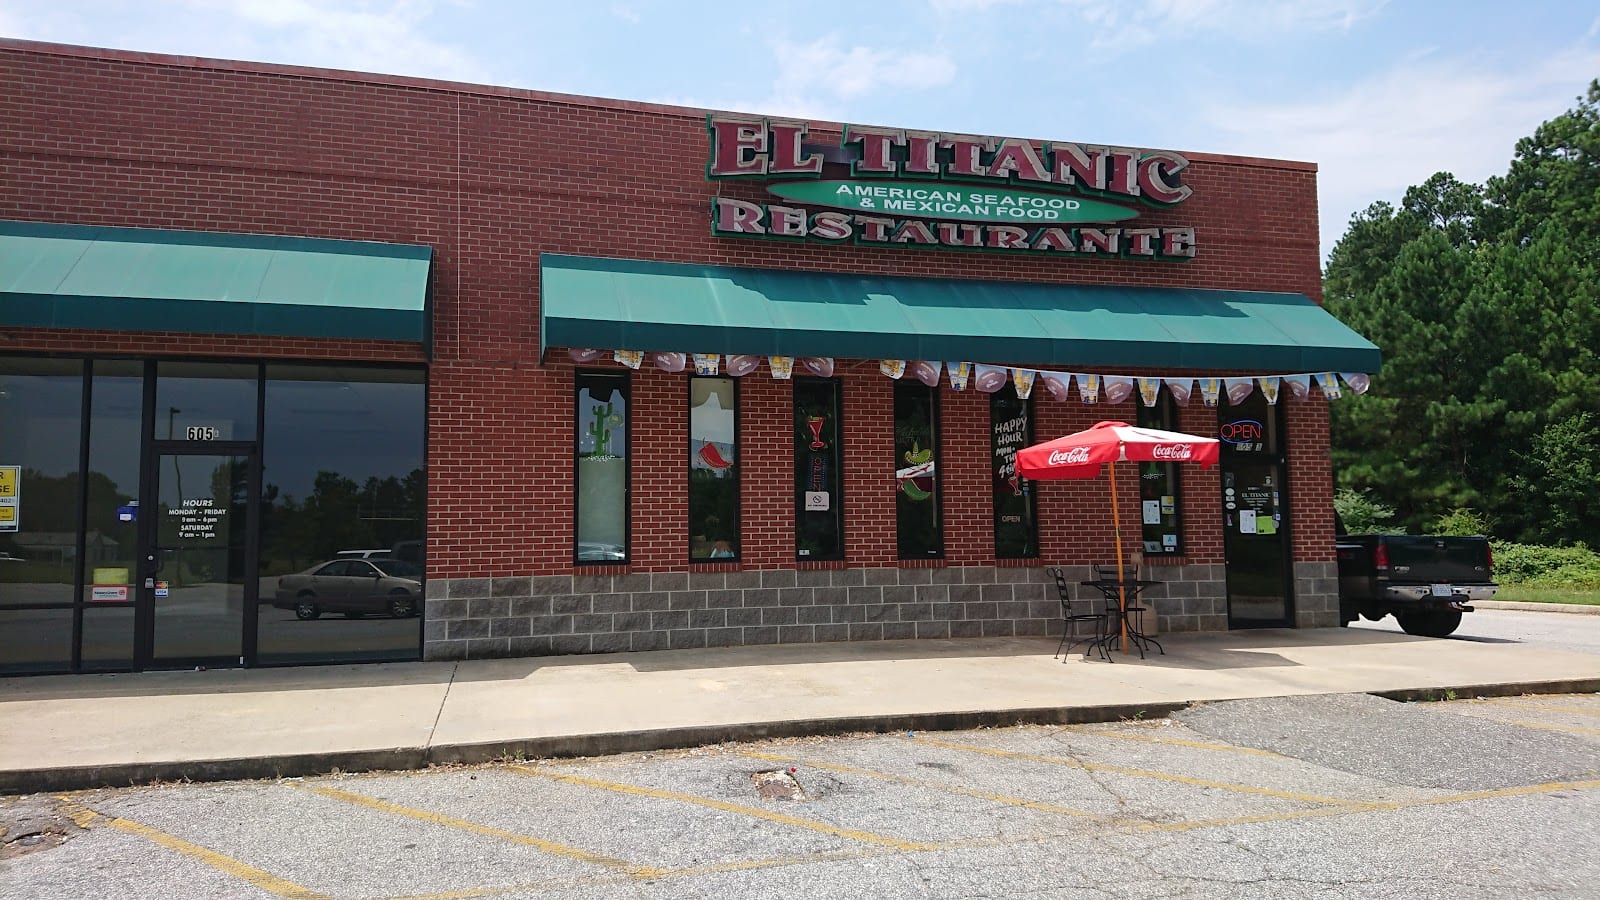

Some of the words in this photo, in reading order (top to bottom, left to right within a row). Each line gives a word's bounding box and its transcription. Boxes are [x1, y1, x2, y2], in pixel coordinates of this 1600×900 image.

[708, 116, 824, 177] EL
[842, 124, 1193, 205] TITANIC
[836, 184, 961, 201] AMERICAN
[969, 193, 1081, 210] SEAFOOD
[859, 198, 875, 208] &
[883, 199, 990, 215] MEXICAN
[996, 206, 1059, 220] FOOD
[714, 198, 1196, 259] RESTAURANTE
[188, 427, 213, 440] 605
[995, 416, 1028, 434] HAPPY
[1220, 423, 1261, 439] OPEN
[998, 432, 1022, 446] HOUR
[1049, 446, 1091, 465] Coca-Cola
[1153, 443, 1192, 459] Coca-Cola
[183, 499, 214, 507] HOURS
